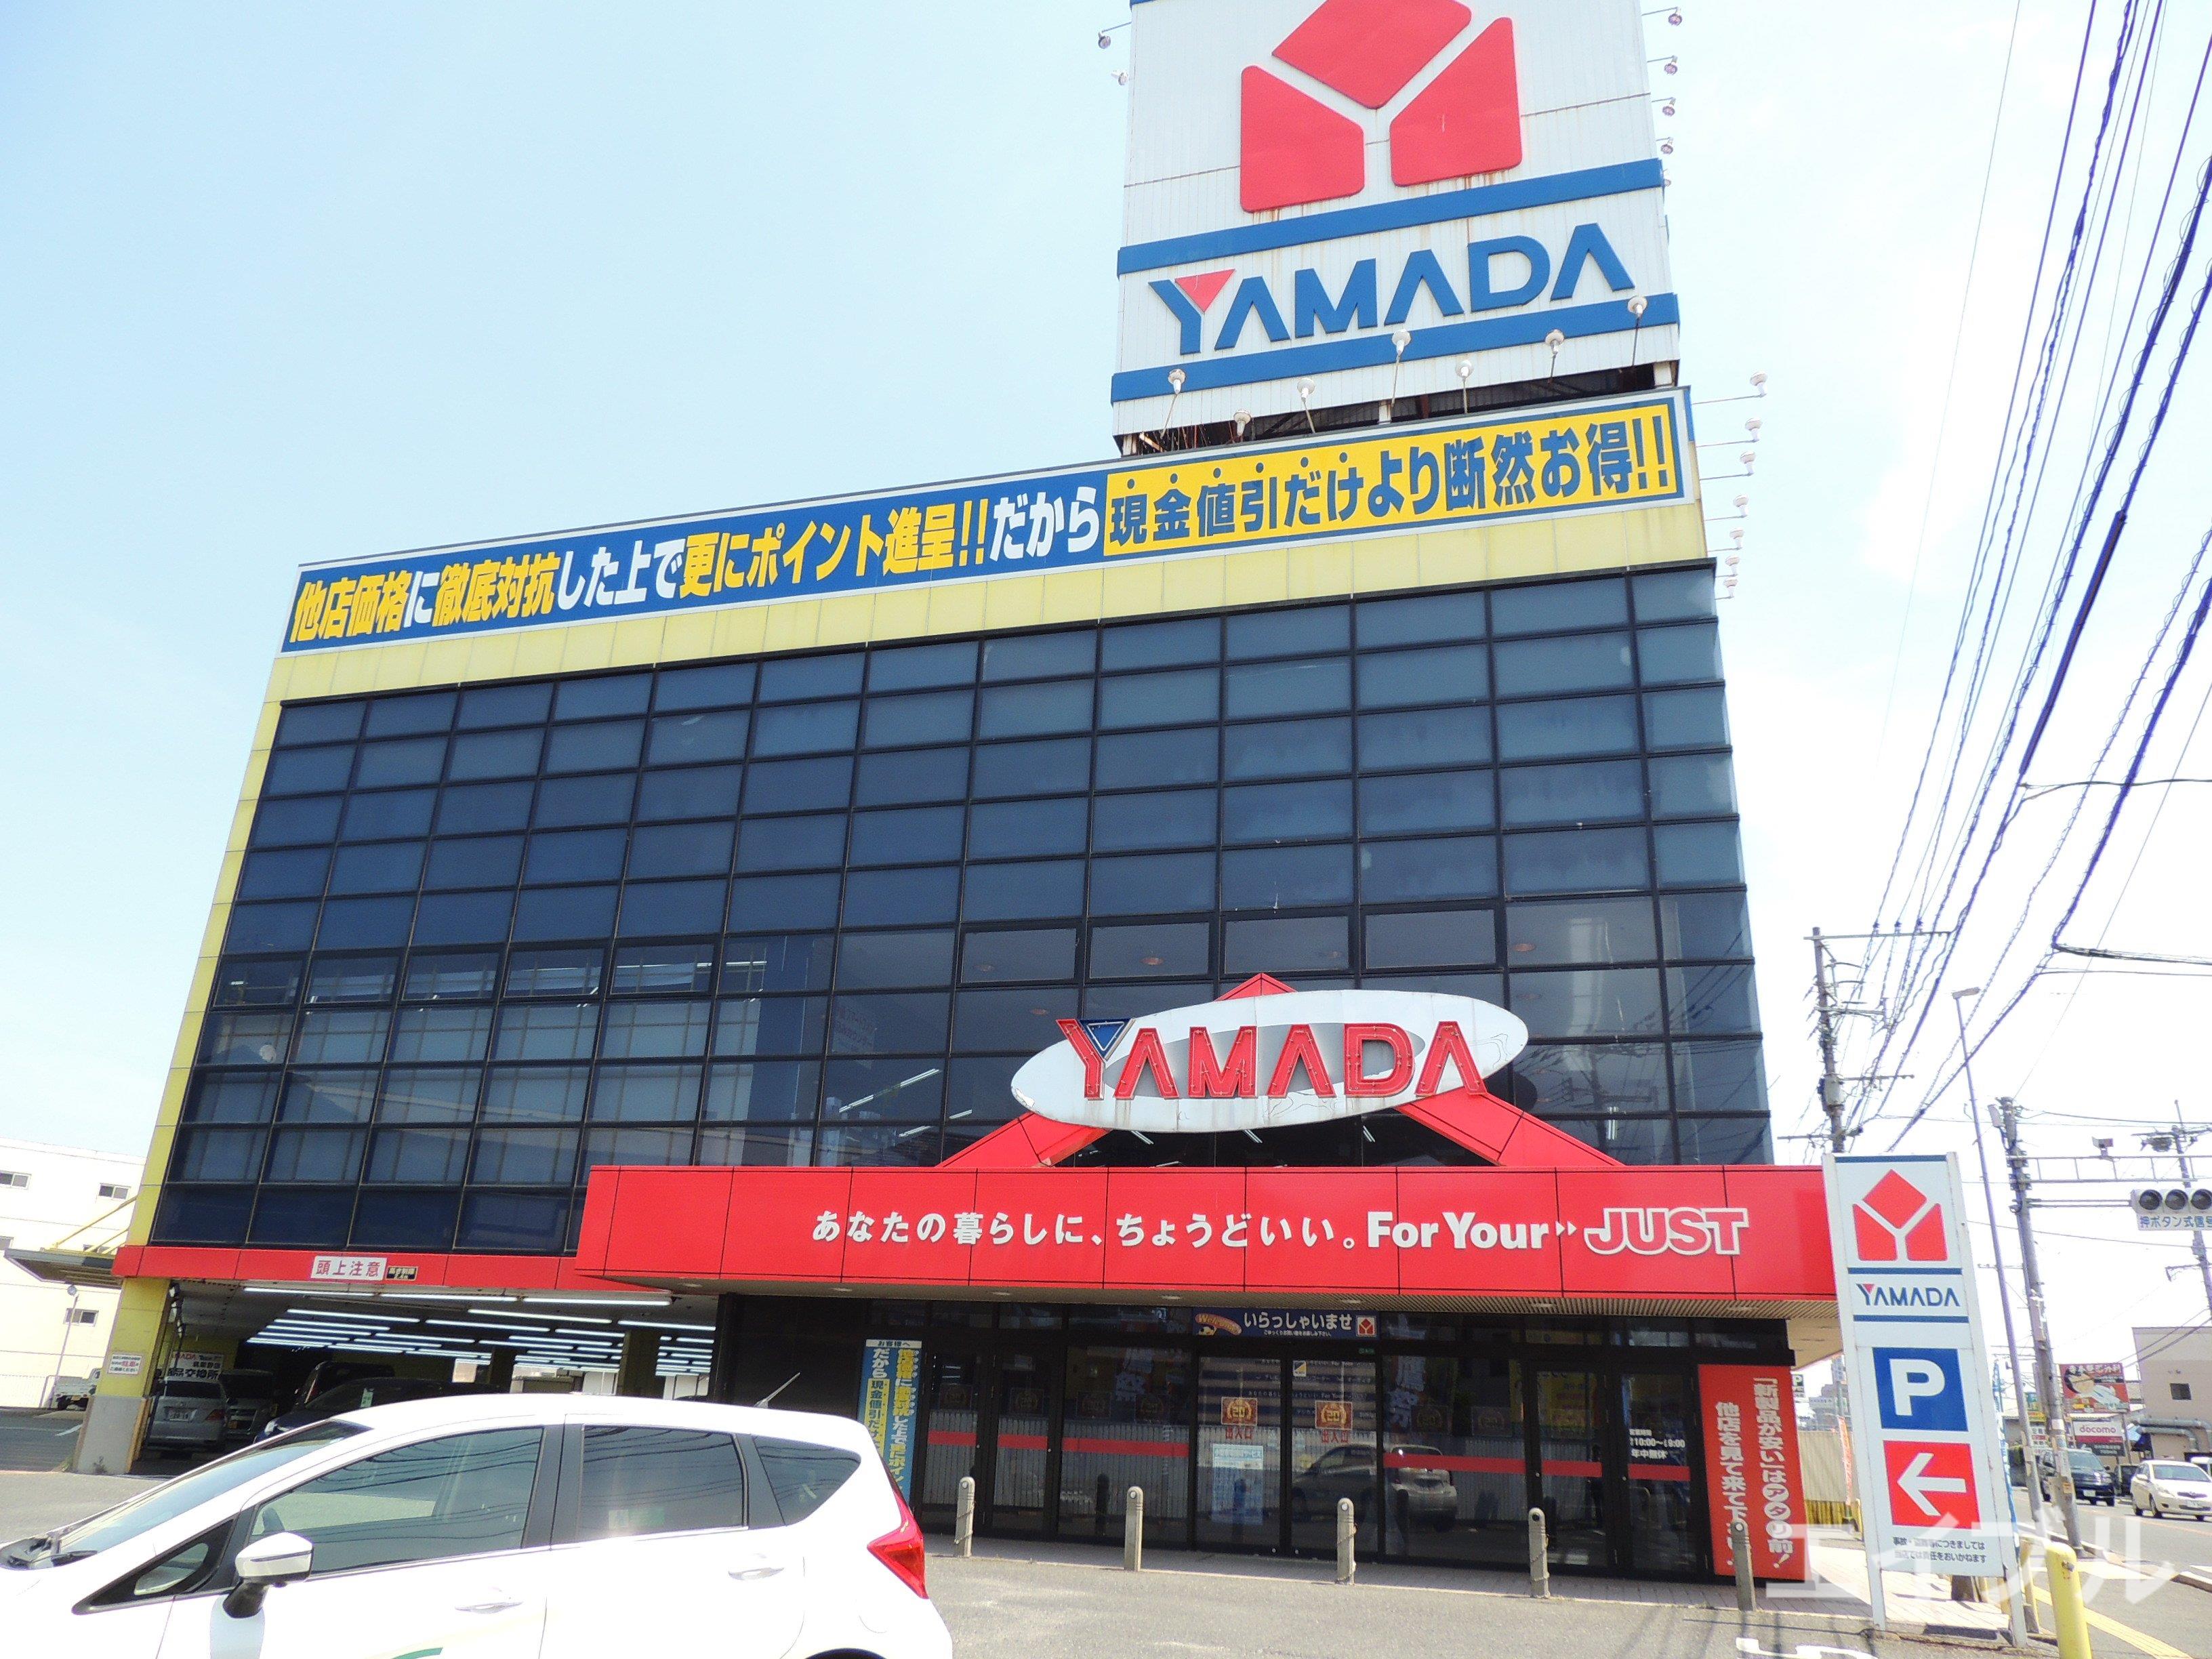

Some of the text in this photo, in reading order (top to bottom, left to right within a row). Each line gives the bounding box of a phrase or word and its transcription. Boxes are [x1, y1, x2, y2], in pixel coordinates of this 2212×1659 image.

[1148, 223, 1635, 355] YAMADA
[1057, 1018, 1490, 1099] YAMADA
[1367, 1212, 1439, 1248] For
[1442, 1212, 1549, 1250] Your
[1583, 1207, 1748, 1256] JUST
[315, 1260, 381, 1277] 頭上注意
[1856, 1283, 1960, 1307] YAMADA
[1243, 1311, 1353, 1330] いらっしゃいませ
[1889, 1359, 1946, 1416] P
[1225, 1427, 1253, 1440] 出入口
[1321, 1431, 1349, 1443] 出入口
[2079, 1425, 2116, 1433] docomo
